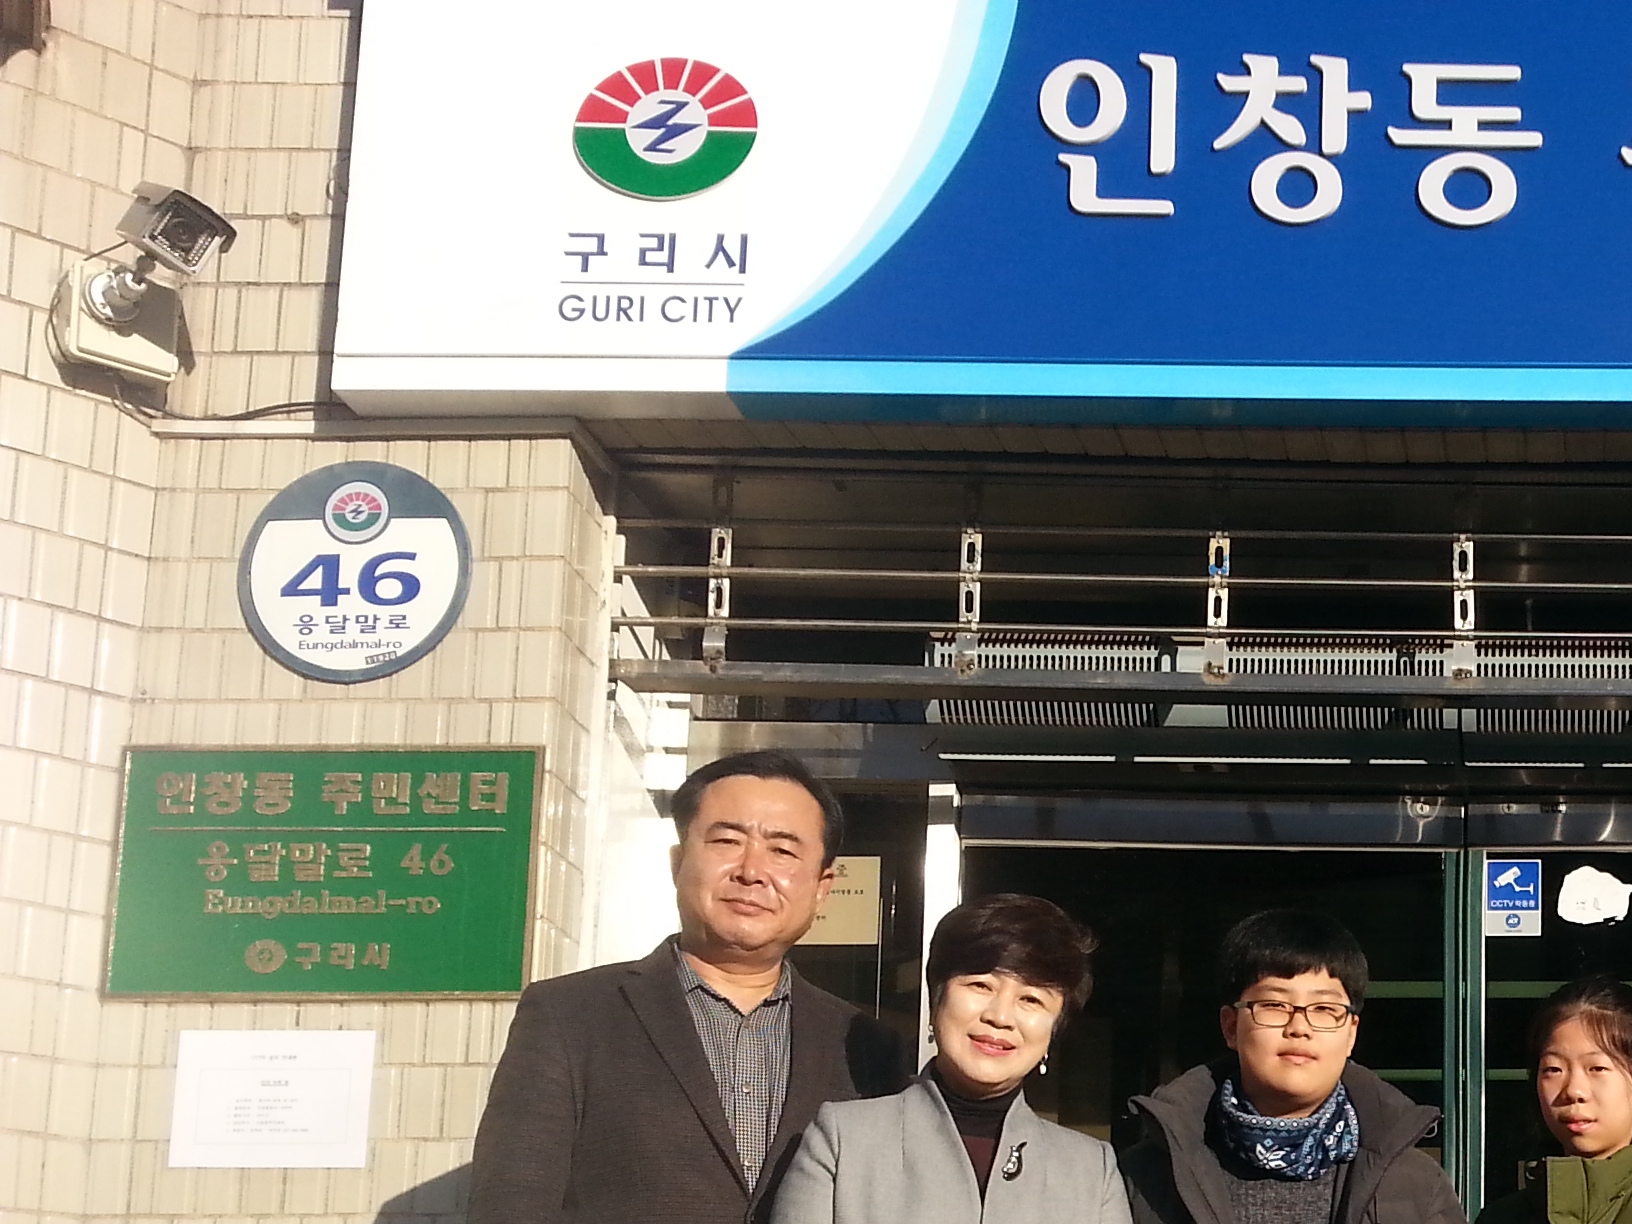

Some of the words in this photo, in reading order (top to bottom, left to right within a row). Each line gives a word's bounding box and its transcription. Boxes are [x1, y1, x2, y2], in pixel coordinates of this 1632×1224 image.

[1038, 52, 1544, 226] 인창동
[563, 232, 749, 275] 구리시
[558, 295, 644, 322] GURI
[661, 296, 742, 324] CITY
[280, 551, 421, 607] 46
[293, 614, 411, 636] 응달말로
[298, 639, 402, 652] Eungdalmal-ro
[154, 771, 294, 815] 인창동
[322, 771, 510, 815] 주민센터
[197, 841, 373, 882] 응달말로
[400, 843, 454, 876] 46
[203, 889, 441, 919] Eungdalmal-ro
[294, 942, 391, 971] 구리시
